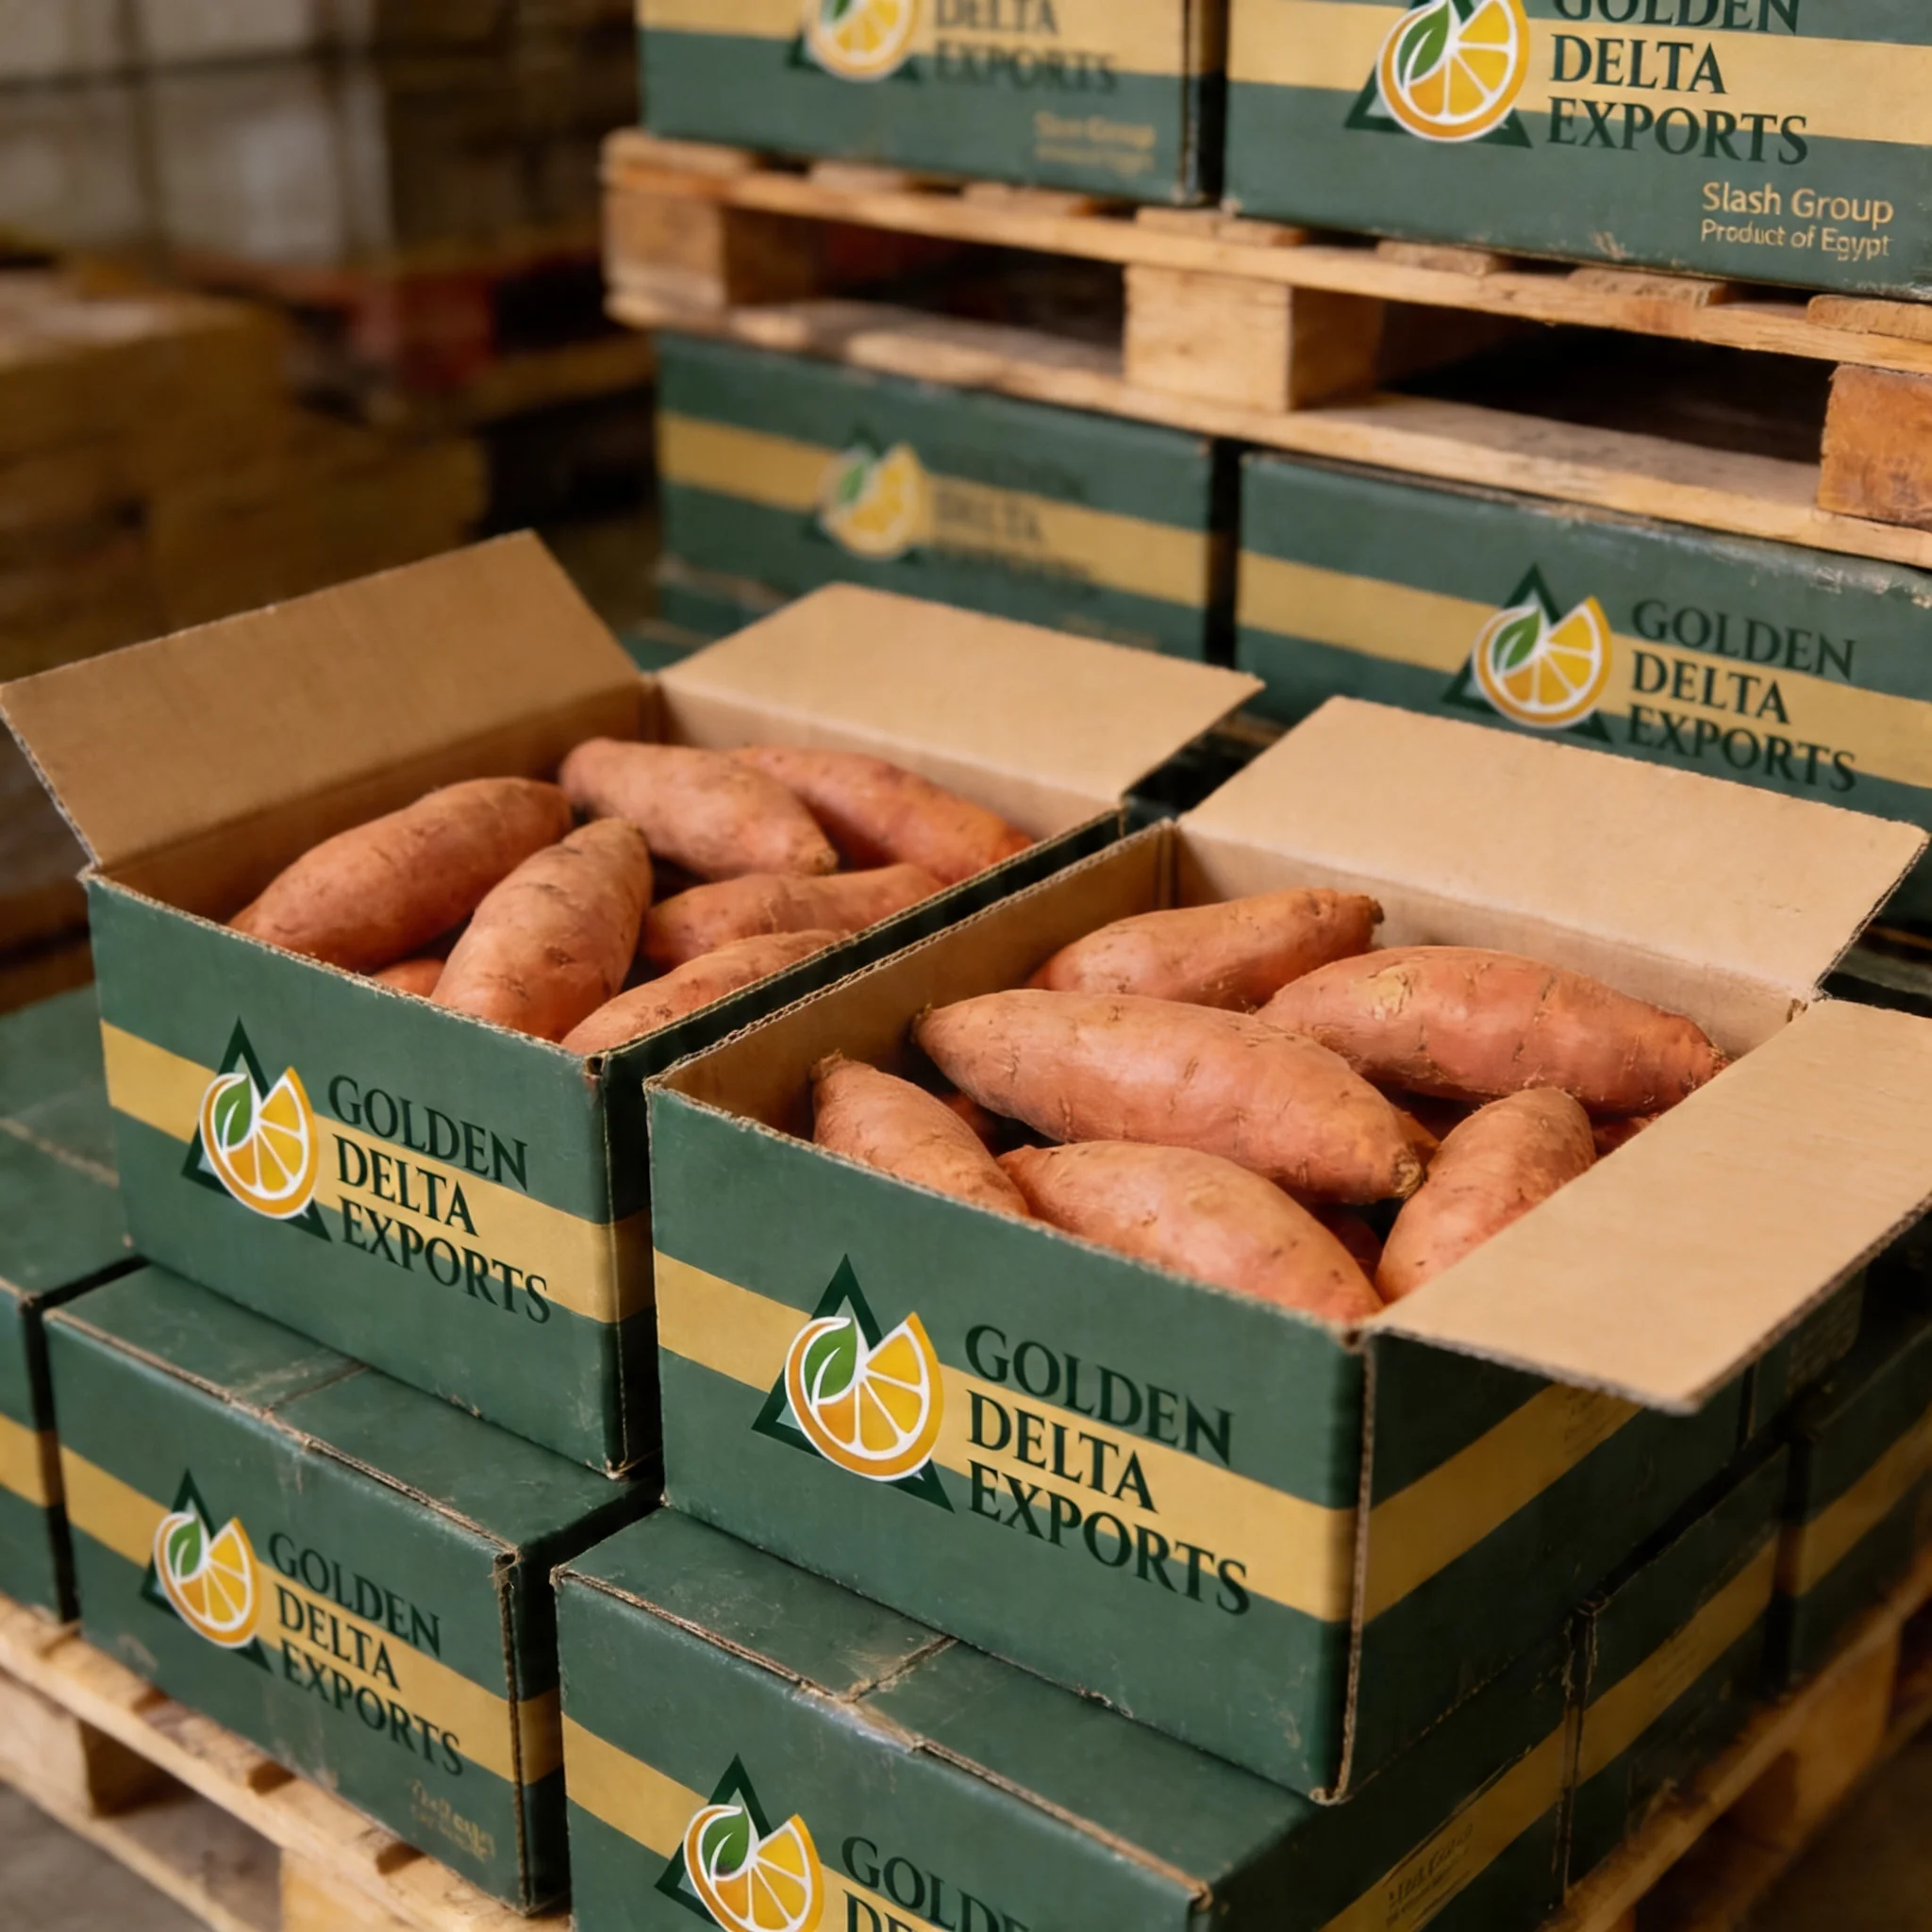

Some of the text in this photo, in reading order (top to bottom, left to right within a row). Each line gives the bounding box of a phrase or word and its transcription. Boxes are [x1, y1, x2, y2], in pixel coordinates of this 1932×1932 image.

[1548, 34, 1729, 94] DELTA
[1547, 96, 1808, 165] EXPORTS
[1700, 218, 1894, 262] Product of Egypt
[1701, 181, 1894, 231] Slash Group
[1631, 599, 1857, 680] GOLDEN
[1631, 650, 1790, 724] DELTA
[1626, 703, 1857, 792] EXPORTS
[328, 1074, 528, 1191] GOLDEN
[332, 1133, 479, 1237] DELTA
[338, 1194, 552, 1324] EXPORTS
[964, 1324, 1235, 1465] GOLDEN
[967, 1390, 1159, 1513] DELTA
[967, 1457, 1251, 1616] EXPORTS
[268, 1532, 441, 1658] GOLDEN
[275, 1582, 402, 1692] DELTA
[280, 1637, 464, 1776] EXPORTS
